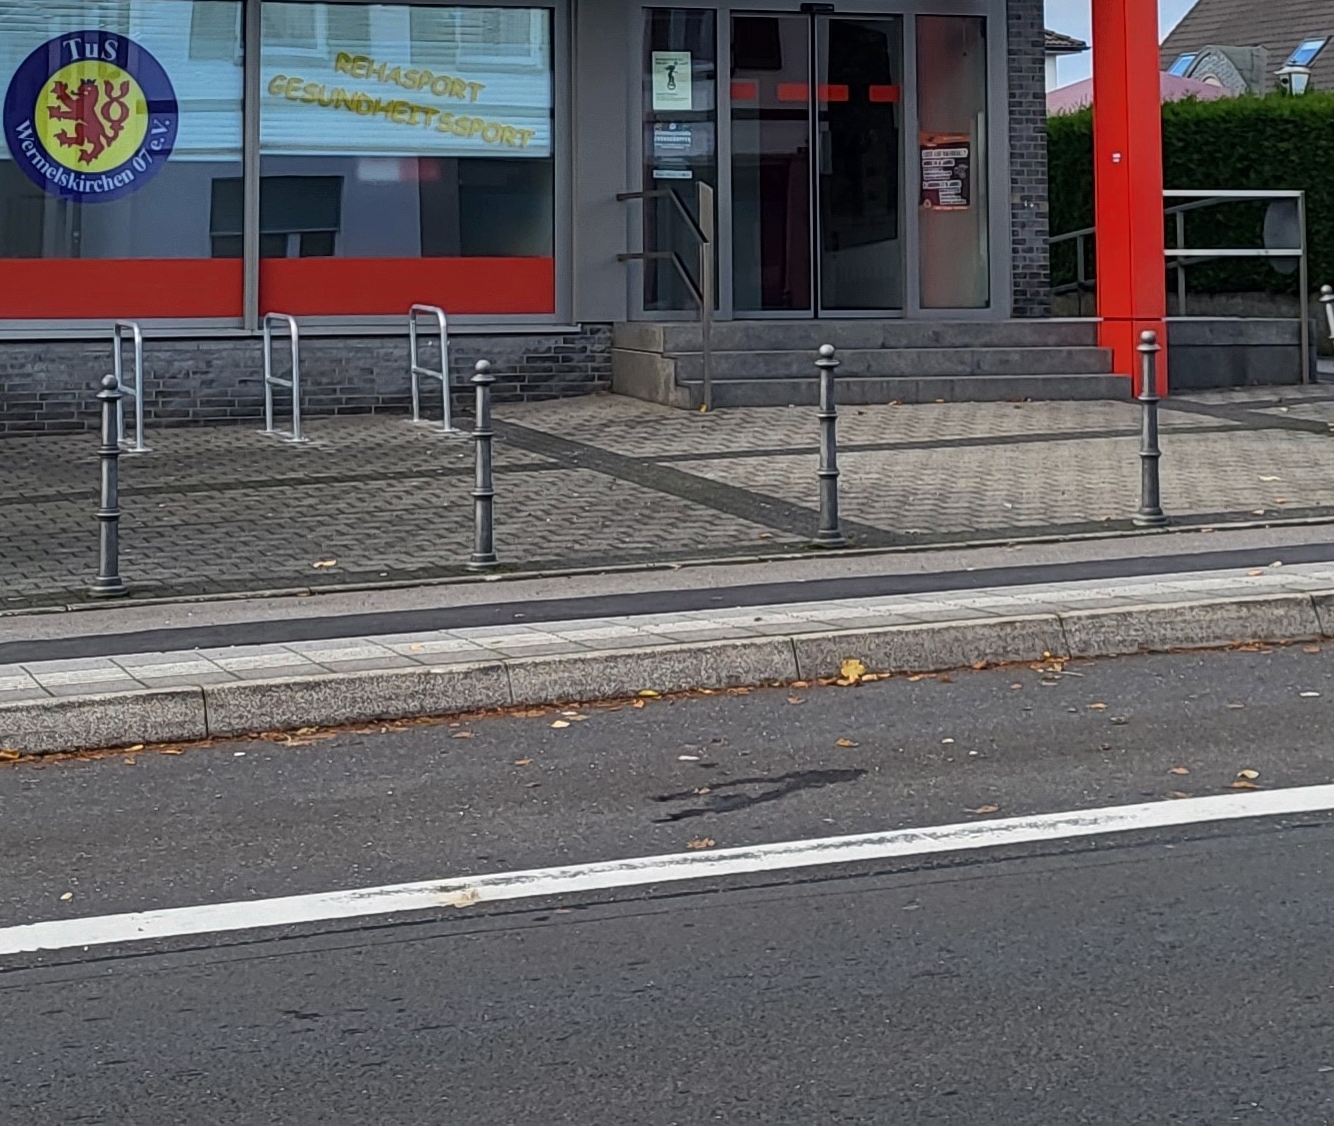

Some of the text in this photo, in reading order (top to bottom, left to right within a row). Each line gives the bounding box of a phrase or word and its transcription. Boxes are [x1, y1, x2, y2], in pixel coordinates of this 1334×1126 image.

[63, 38, 119, 61] TuS
[333, 51, 486, 103] REHASPORT
[268, 74, 536, 149] GESUNDHEITSSPORT
[16, 119, 171, 193] Wermelskirchen 07 e.V.
